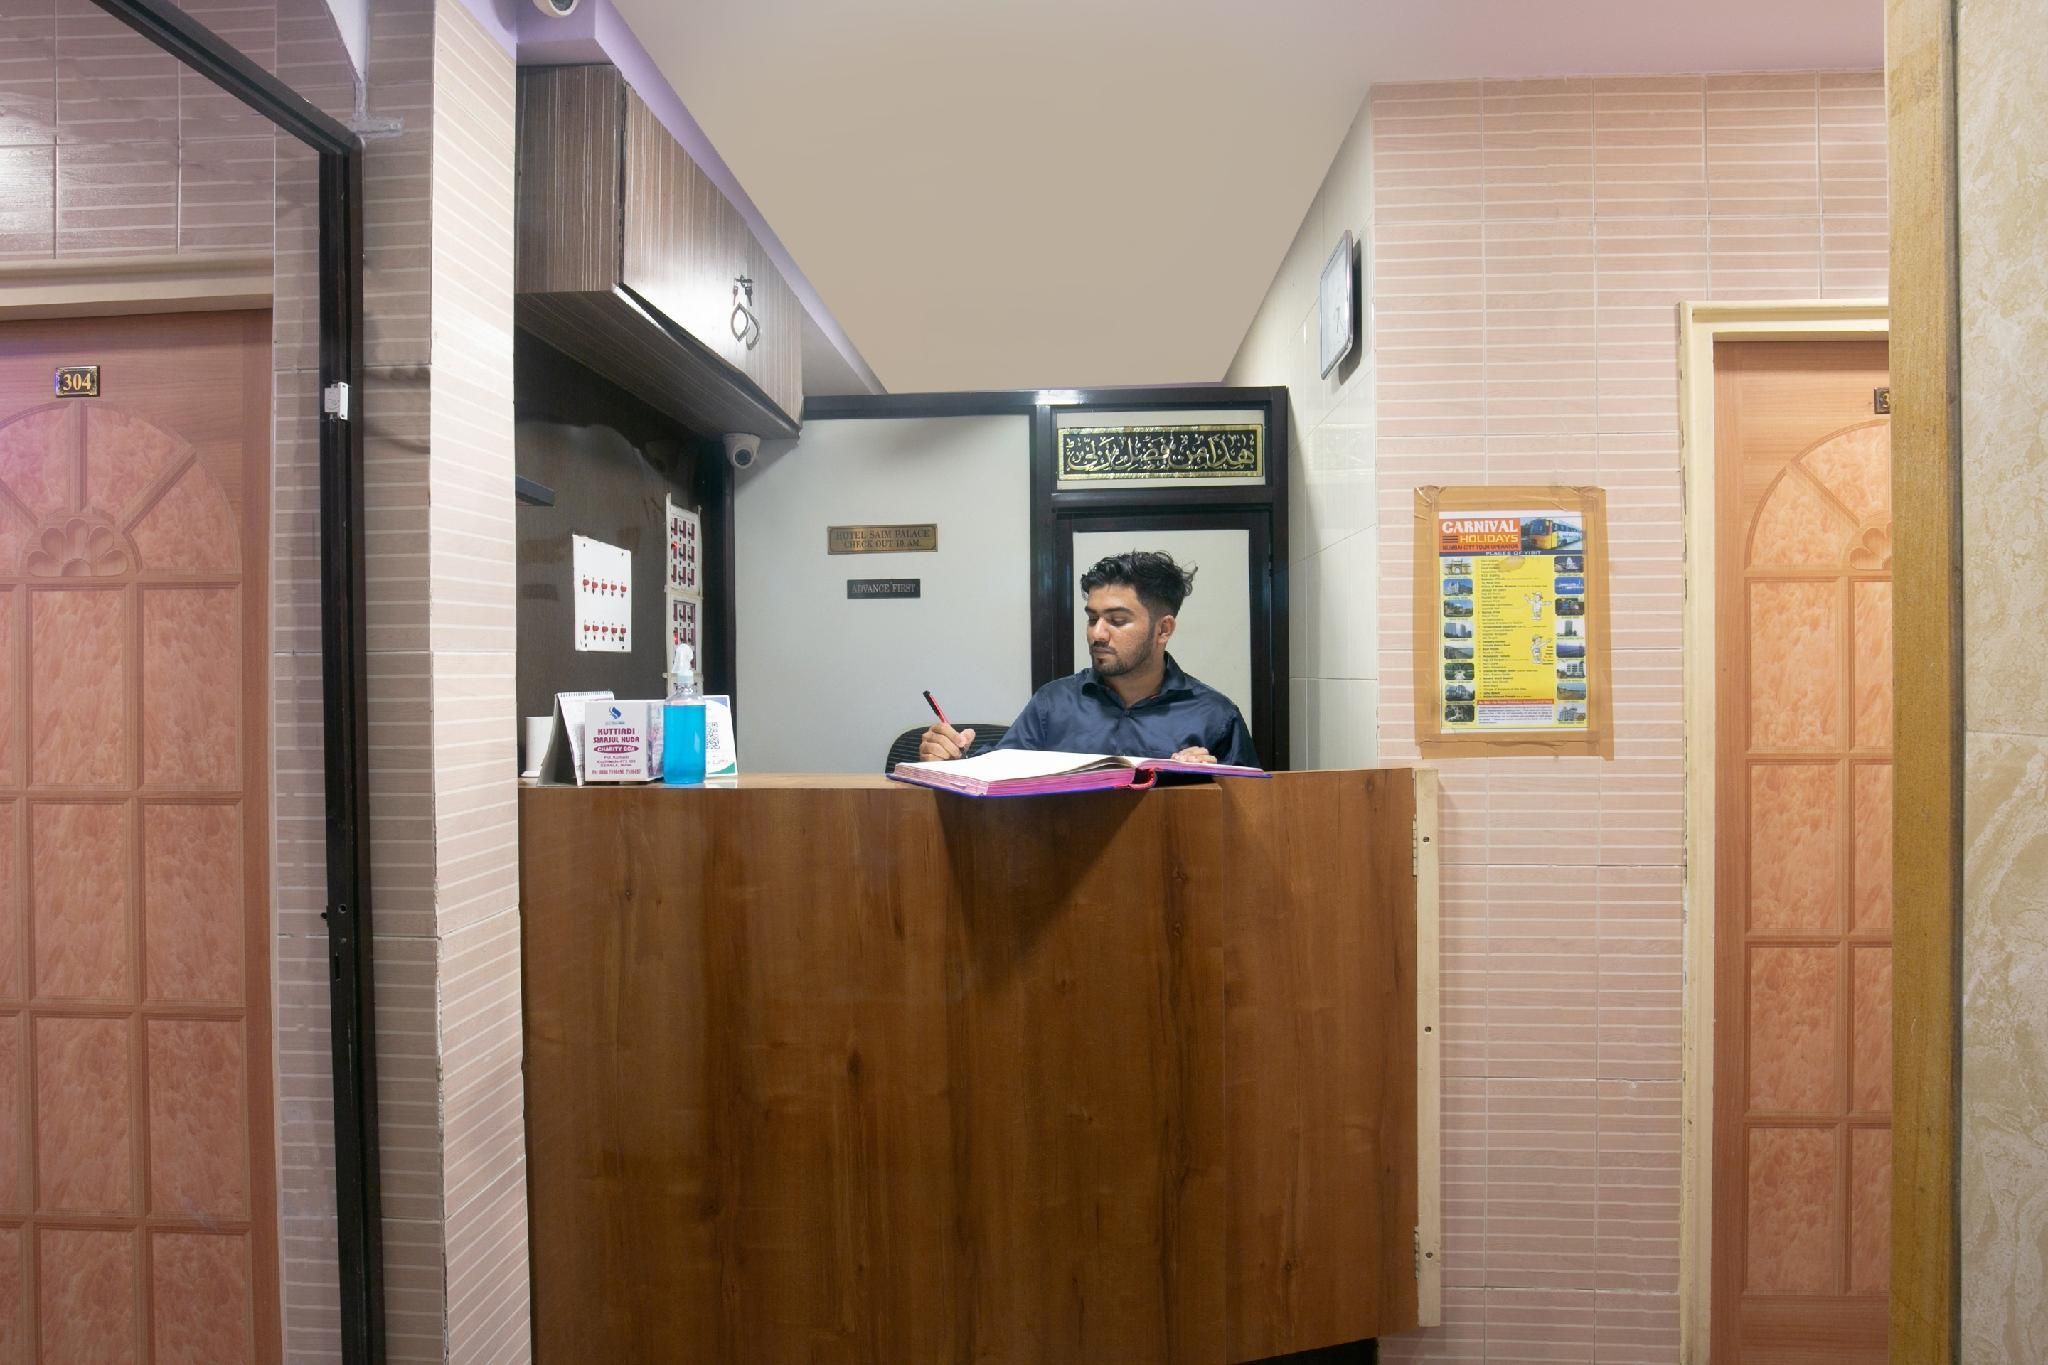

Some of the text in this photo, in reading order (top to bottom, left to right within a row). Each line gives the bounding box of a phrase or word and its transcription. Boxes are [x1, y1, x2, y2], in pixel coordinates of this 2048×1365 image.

[63, 373, 92, 391] 304
[895, 528, 930, 538] PALACE
[1460, 534, 1518, 543] HOLIDAYS
[875, 540, 894, 549] OUT
[851, 583, 916, 593] ADVANCE FIRST
